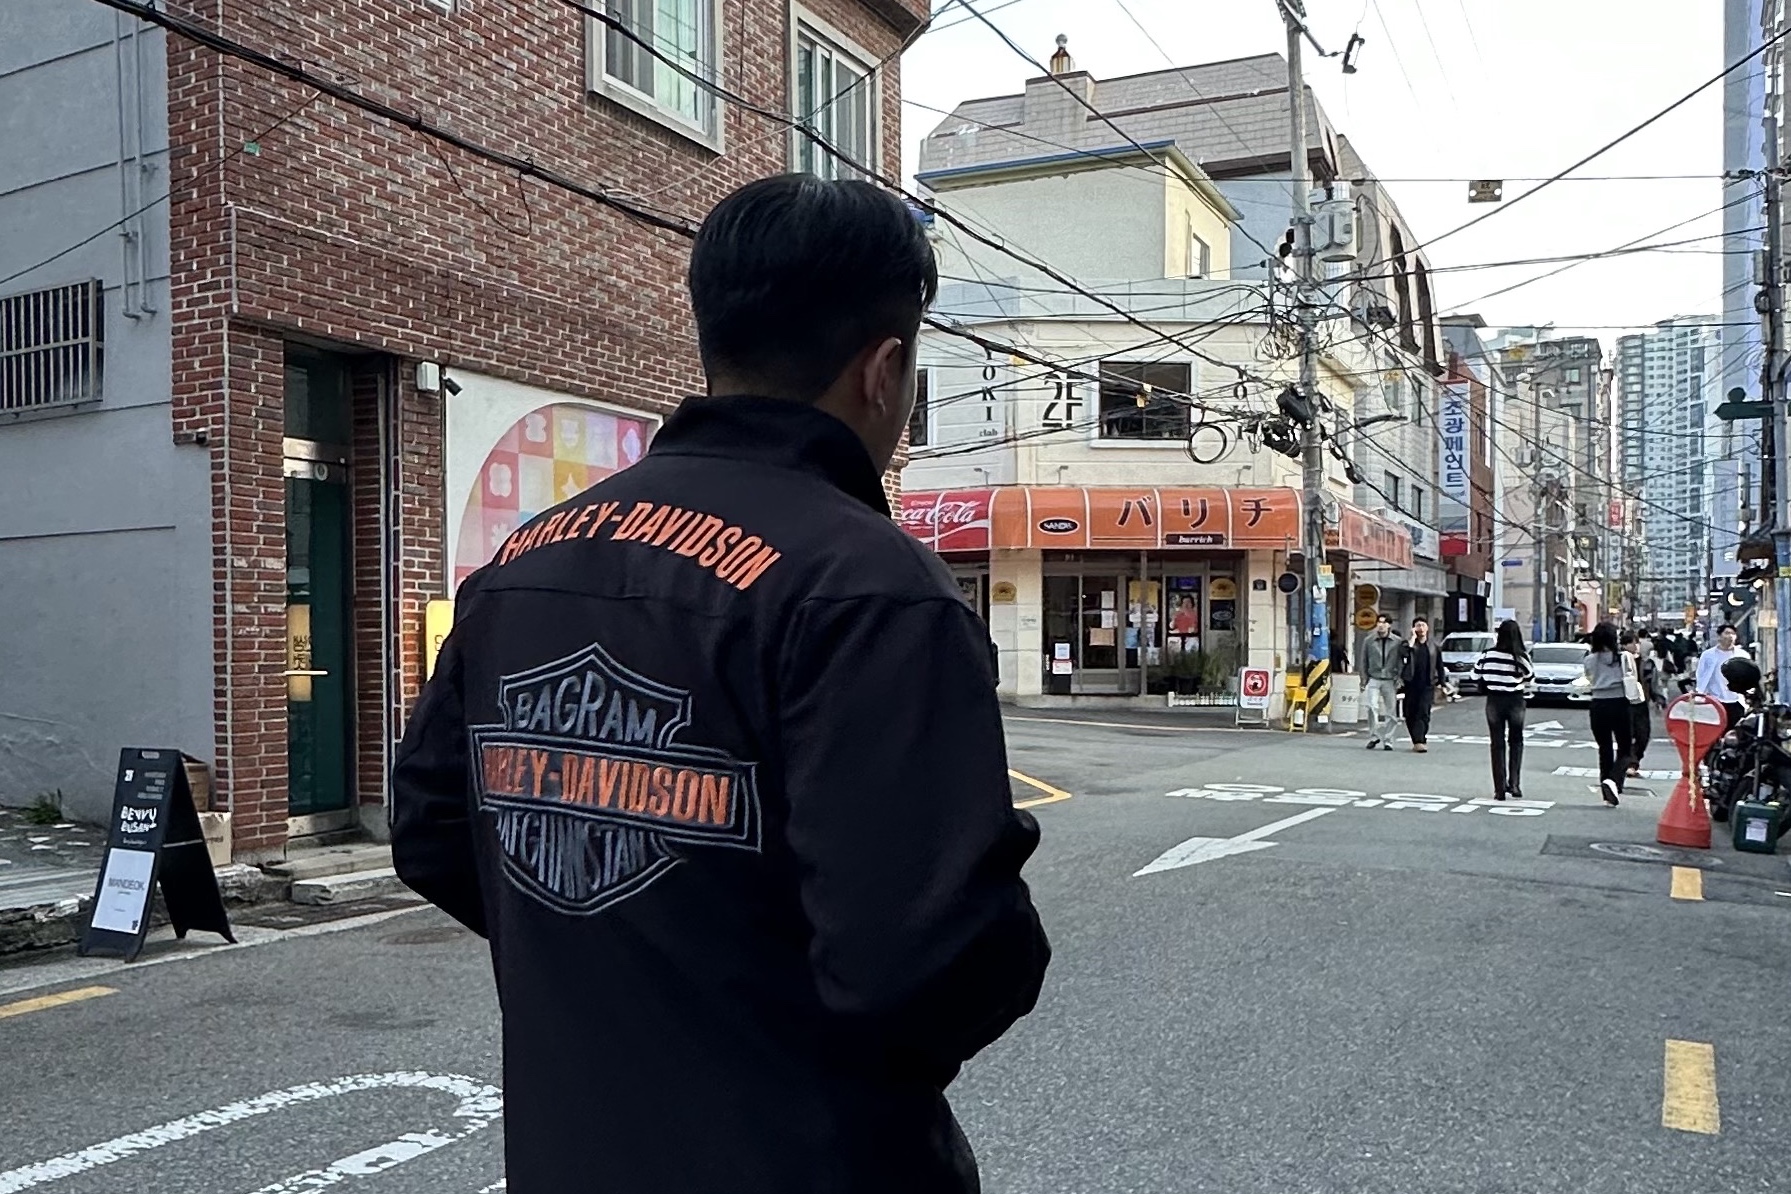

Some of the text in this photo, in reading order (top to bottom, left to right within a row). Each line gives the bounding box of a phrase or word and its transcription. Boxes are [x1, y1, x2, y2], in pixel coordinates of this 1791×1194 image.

[1042, 373, 1083, 428] 2F
[1443, 401, 1465, 488] 조광페인트
[499, 501, 781, 591] HARLEY-DAVIDSON
[1116, 496, 1274, 529] バリチ
[513, 670, 658, 745] BAGRAM
